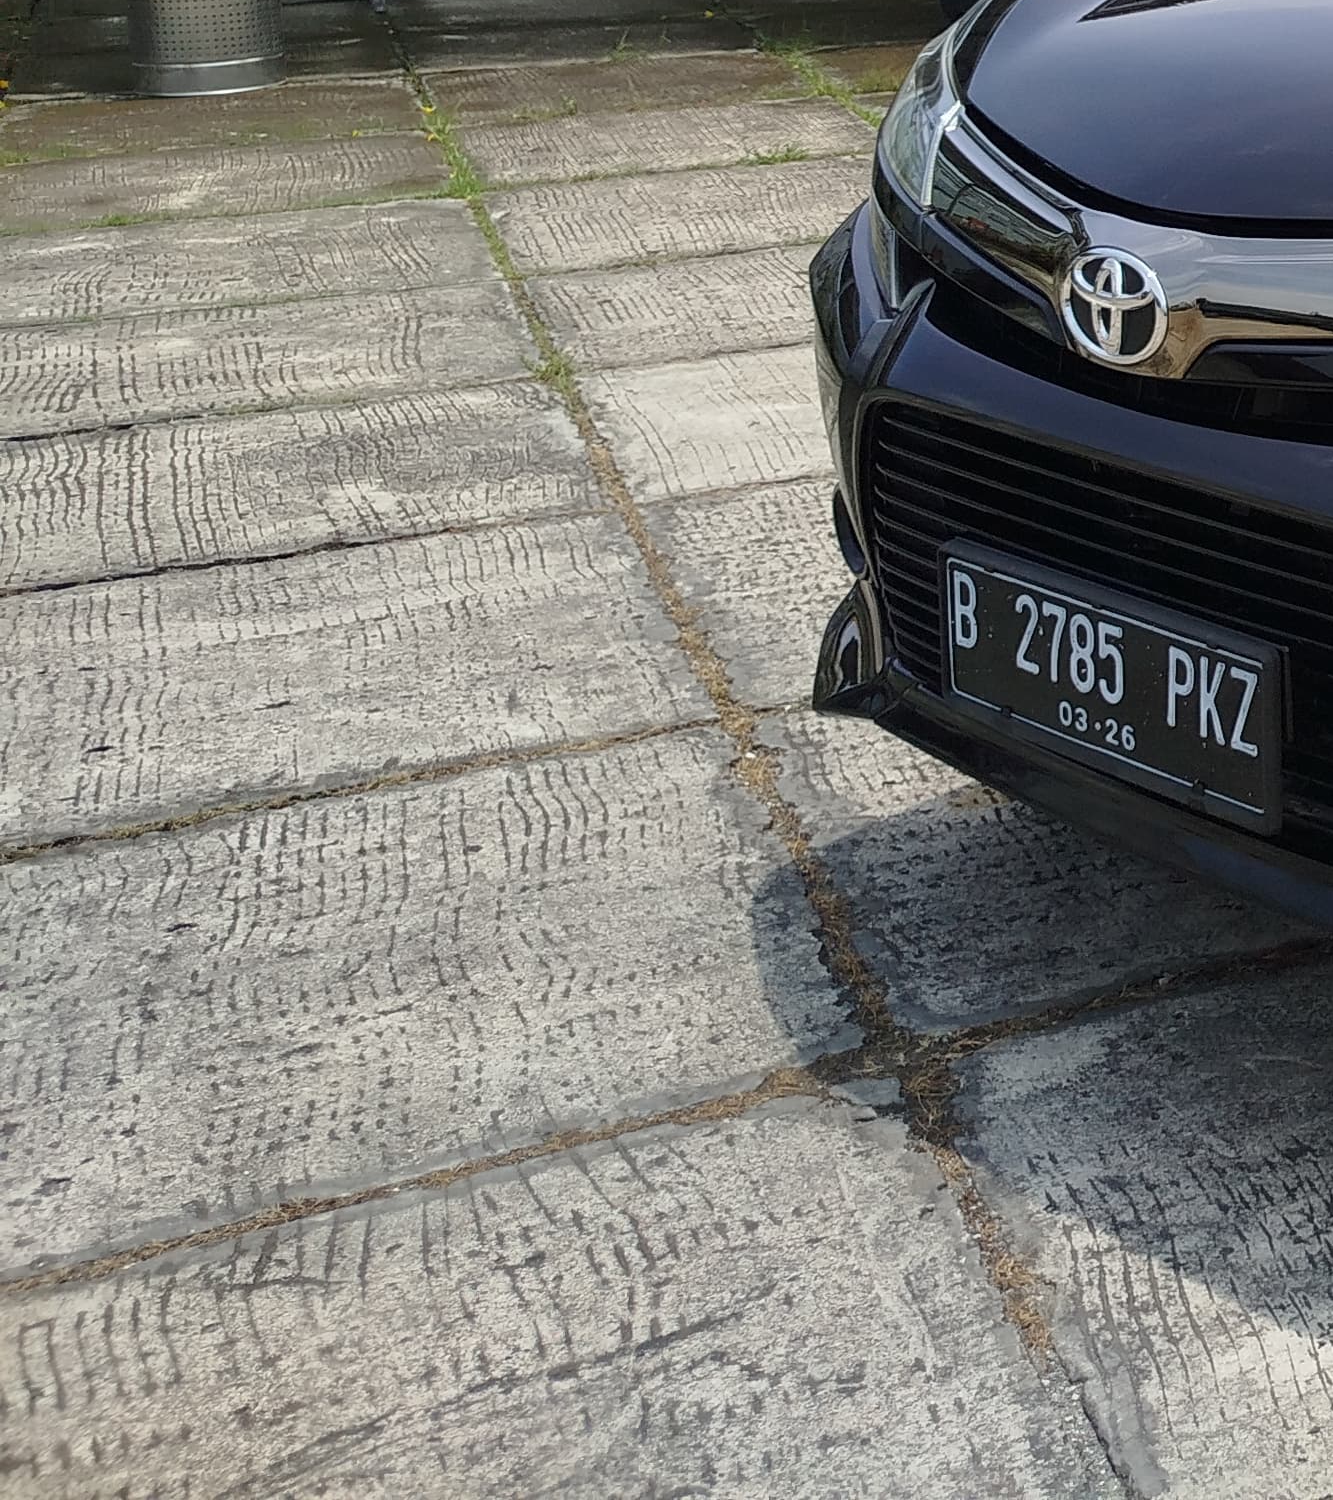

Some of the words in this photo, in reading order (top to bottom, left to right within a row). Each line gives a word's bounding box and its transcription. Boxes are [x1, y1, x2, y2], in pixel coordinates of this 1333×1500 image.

[953, 570, 978, 649] B
[1015, 594, 1124, 704] 2785
[1167, 646, 1258, 757] PKZ
